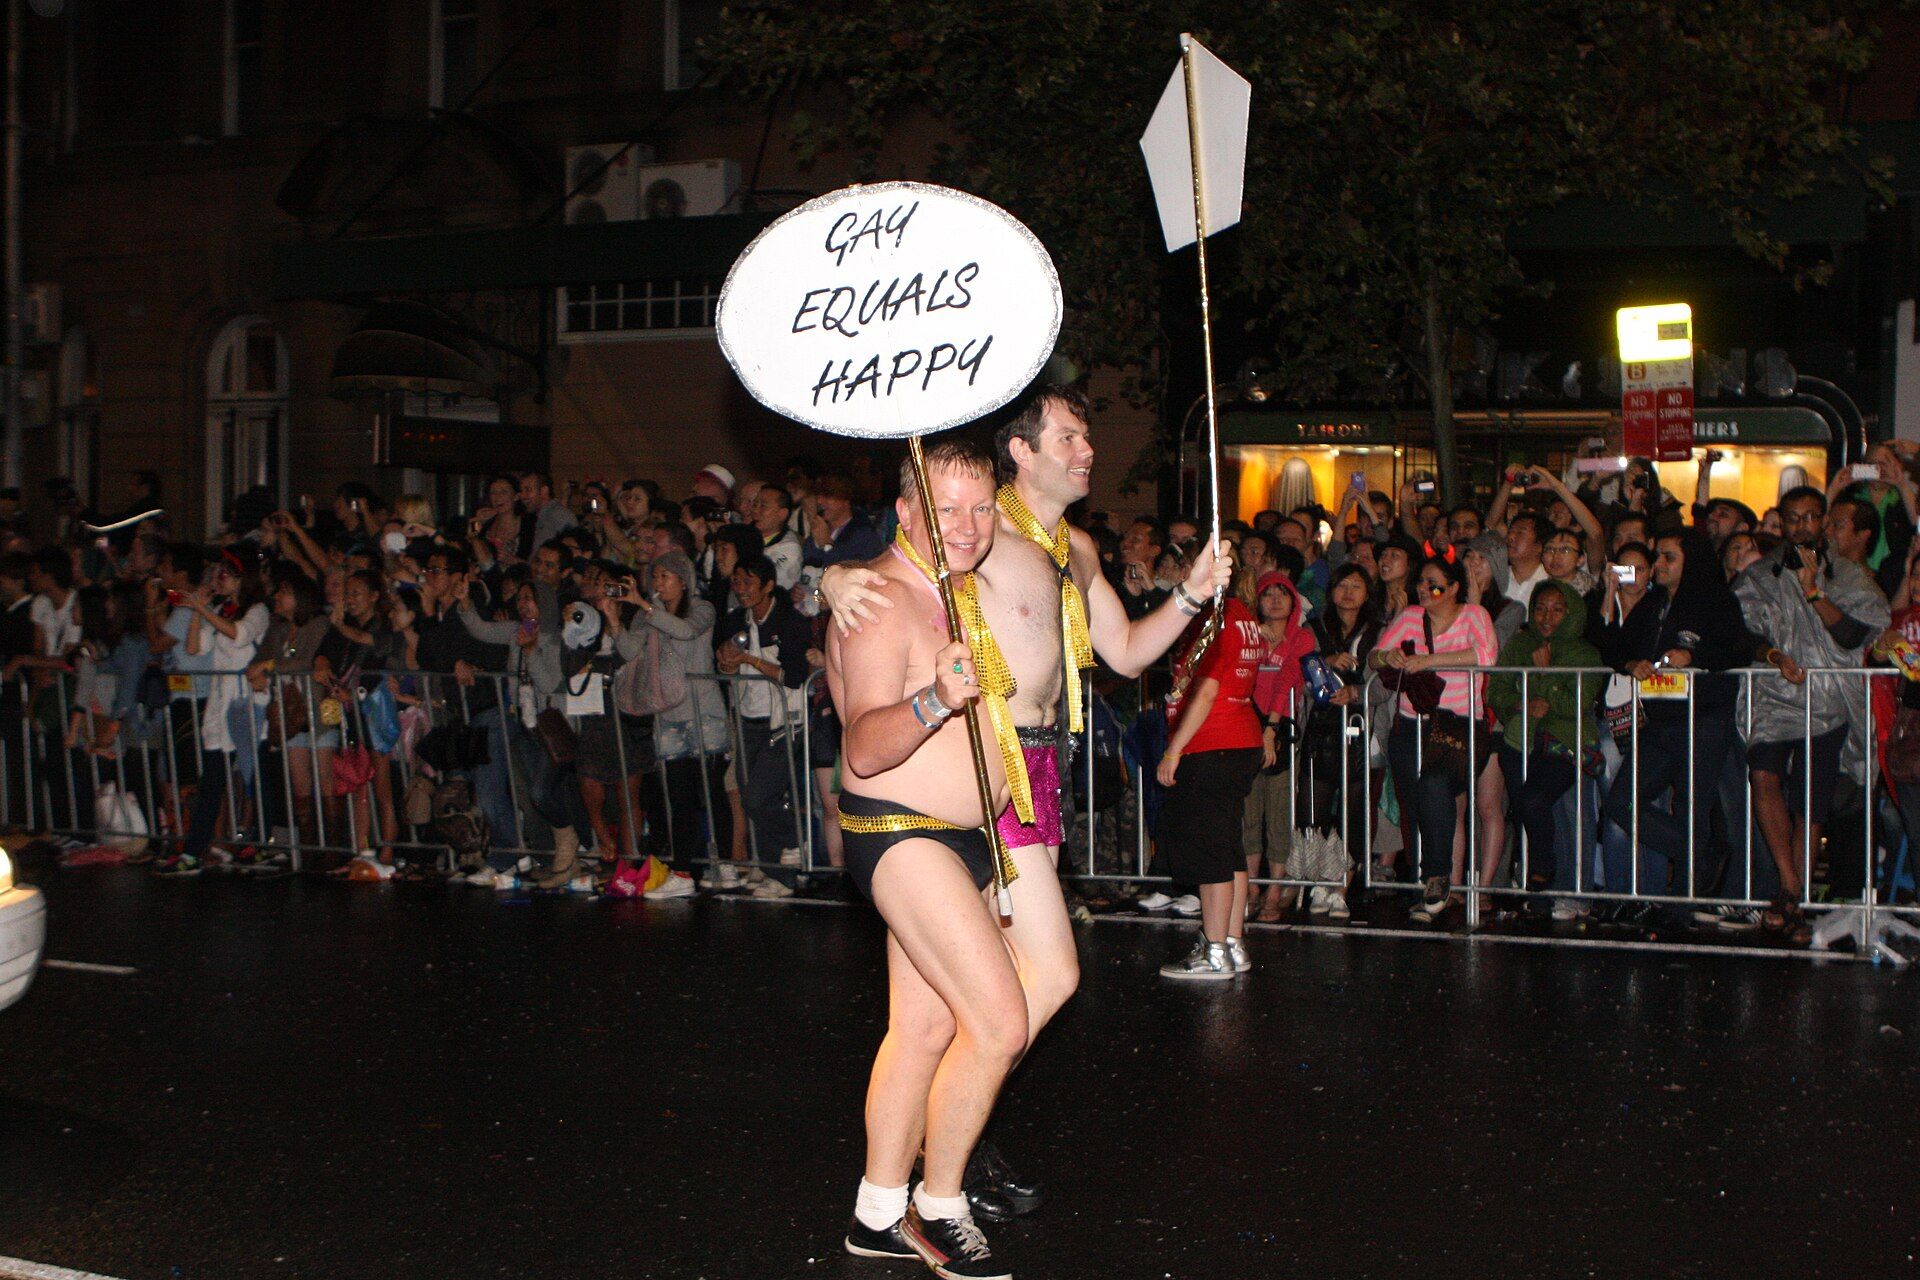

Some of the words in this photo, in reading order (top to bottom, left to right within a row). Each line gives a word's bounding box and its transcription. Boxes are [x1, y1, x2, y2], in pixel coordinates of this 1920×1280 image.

[825, 201, 920, 267] GAY
[791, 261, 980, 338] EQUALS
[812, 335, 994, 407] HAPPY
[1630, 395, 1647, 407] NO
[1660, 407, 1691, 419] STOPPING
[1667, 392, 1683, 405] NO
